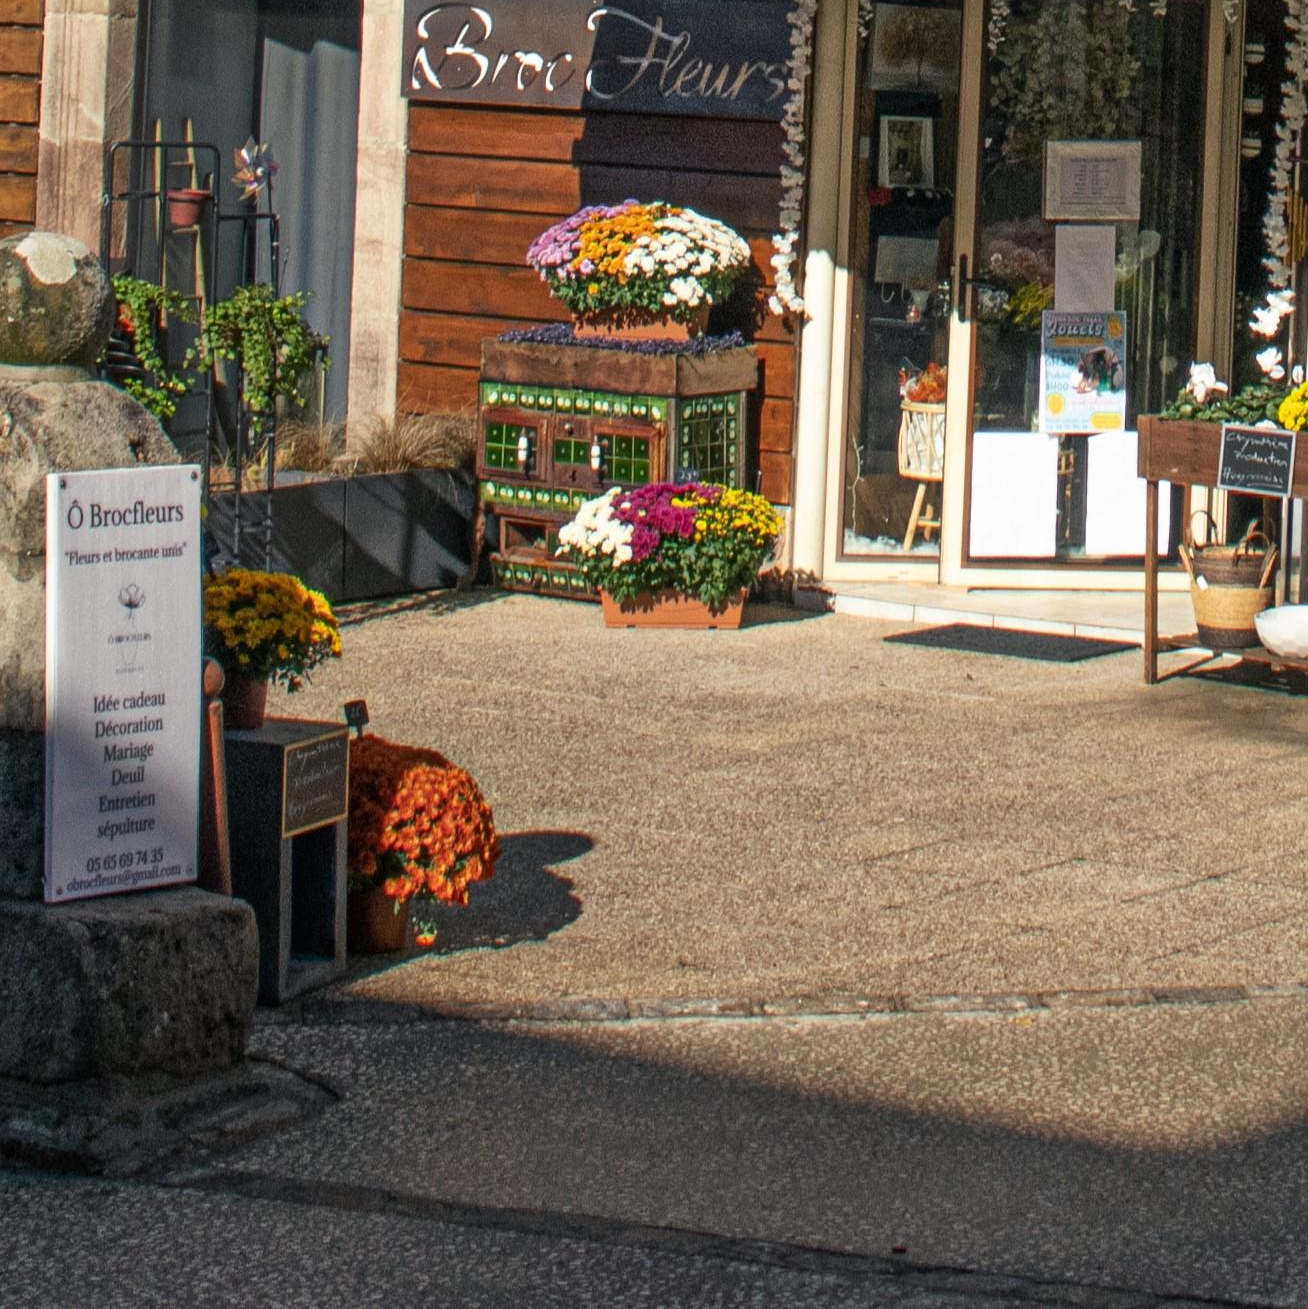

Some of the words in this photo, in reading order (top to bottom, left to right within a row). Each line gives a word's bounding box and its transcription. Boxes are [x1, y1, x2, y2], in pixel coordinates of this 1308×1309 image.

[67, 499, 84, 530] Ô
[90, 500, 184, 529] Brocfleurs
[103, 551, 113, 563] et
[114, 548, 160, 562] brocante
[93, 694, 120, 714] Idée
[122, 690, 166, 710] cadeau
[95, 715, 163, 738] Décoration
[103, 742, 154, 763] Mariage
[111, 765, 145, 787] Deuil
[99, 791, 156, 813] Entretien
[97, 815, 156, 841] sépulture
[87, 857, 101, 873] 05
[103, 854, 117, 871] 65
[119, 851, 134, 869] 69
[135, 849, 148, 866] 74
[150, 847, 164, 863] 35
[66, 864, 182, 893] obrocfleurs@gmail.com
